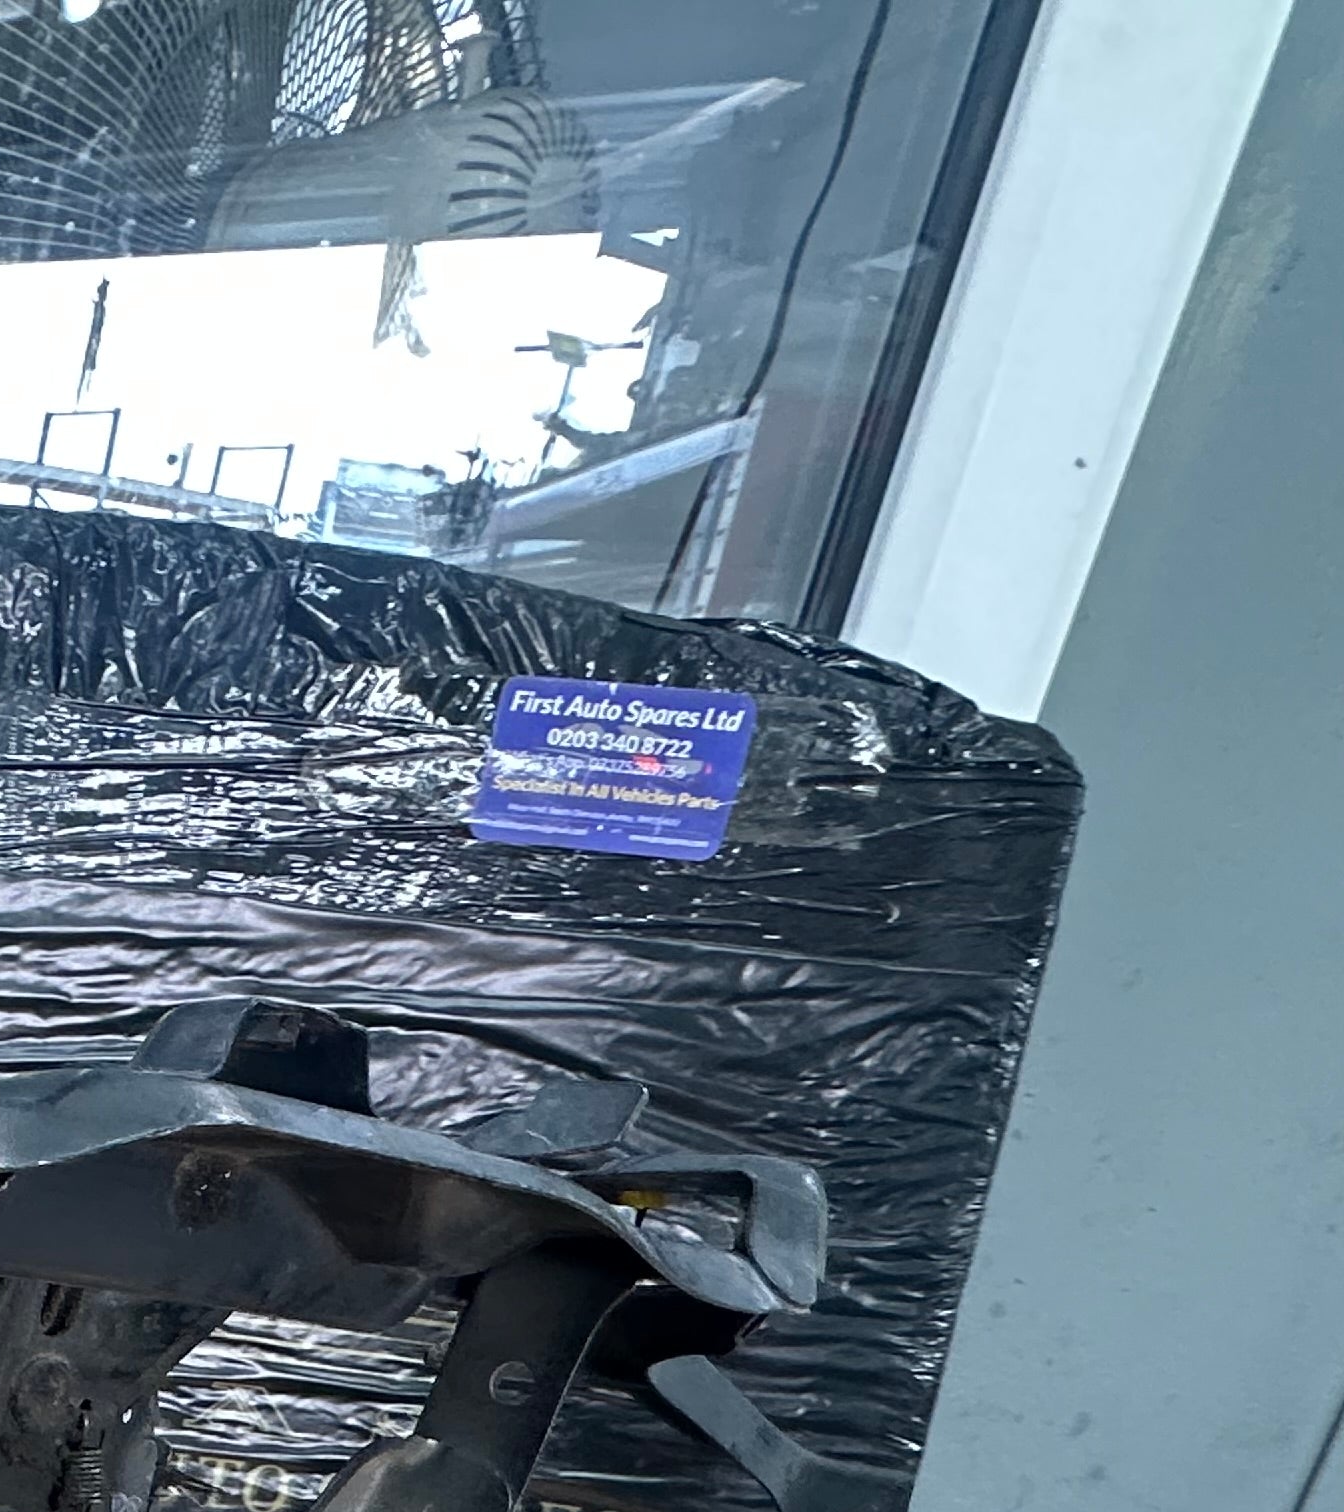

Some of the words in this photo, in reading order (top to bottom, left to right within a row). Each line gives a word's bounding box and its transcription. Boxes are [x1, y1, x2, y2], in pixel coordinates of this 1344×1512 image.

[510, 690, 563, 716] First
[563, 695, 622, 721] Auto
[624, 700, 701, 729] Spares
[702, 707, 745, 732] Ltd
[546, 728, 599, 749] 0203
[600, 731, 639, 754] 340
[640, 735, 694, 758] 8722
[585, 783, 611, 799] All
[612, 785, 677, 805] Vehicles
[677, 792, 720, 810] Parts
